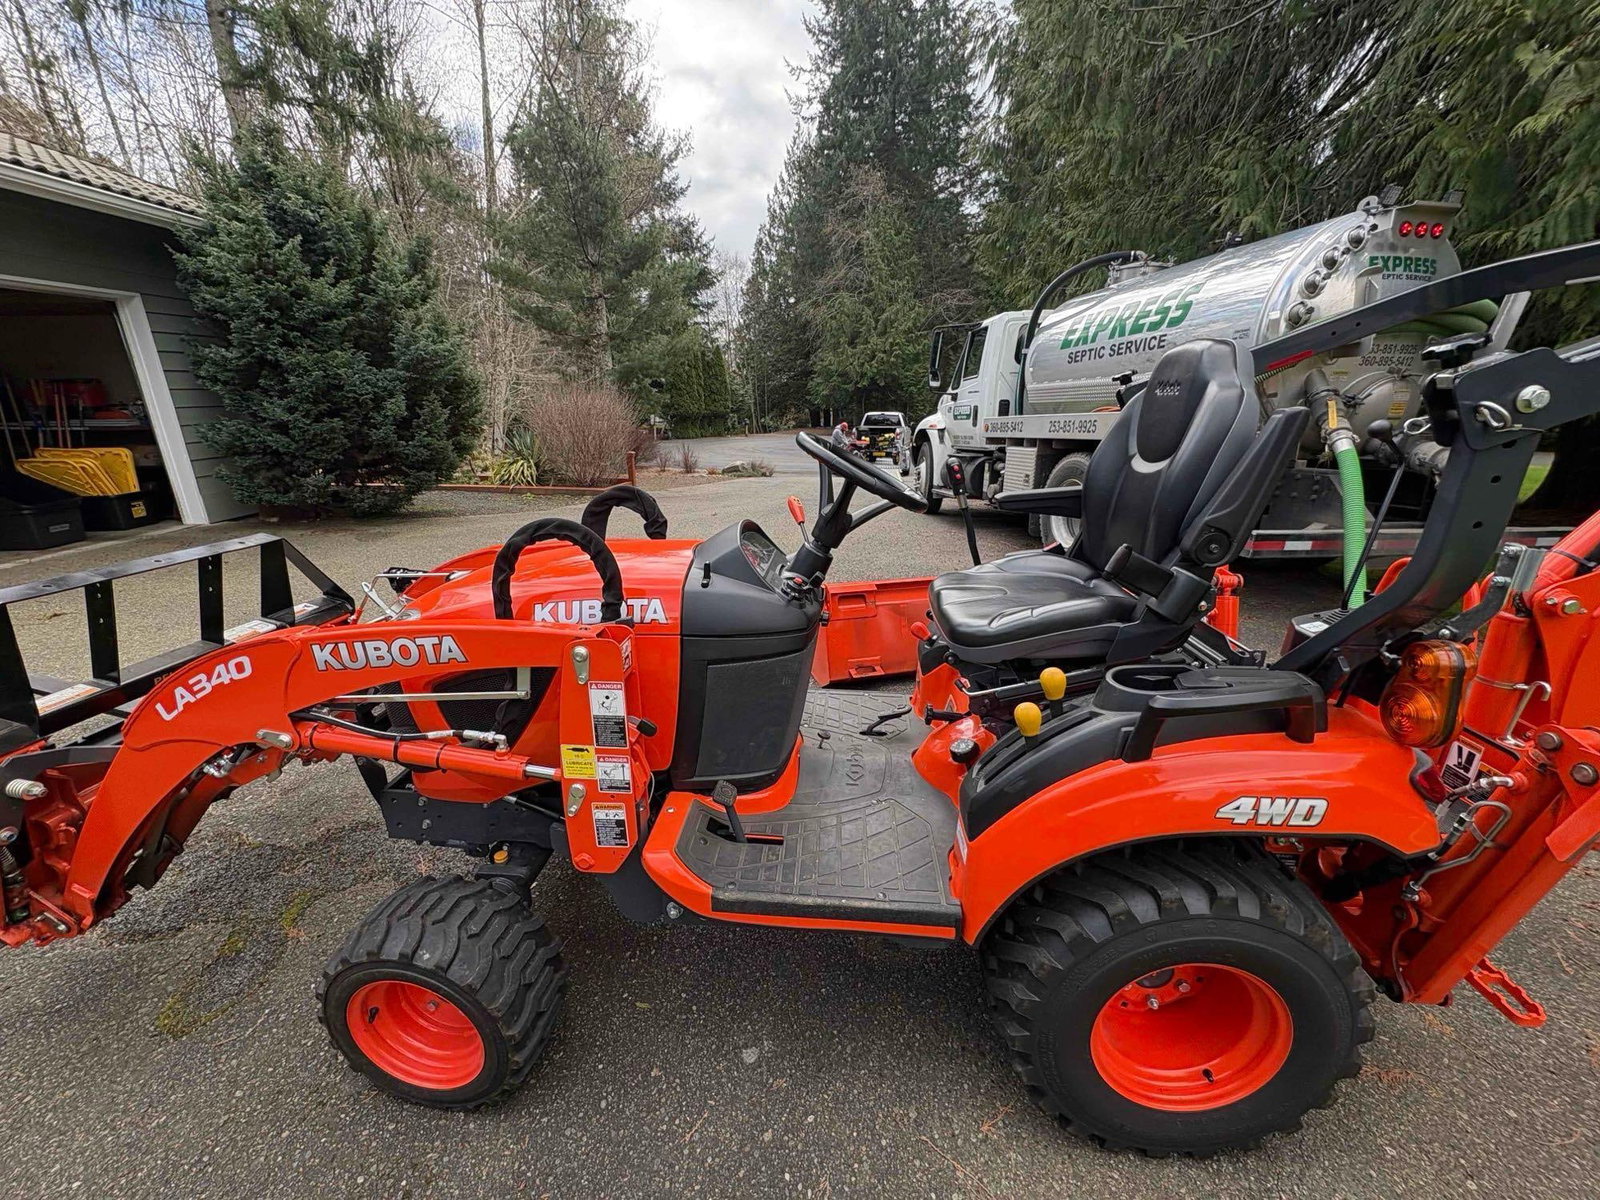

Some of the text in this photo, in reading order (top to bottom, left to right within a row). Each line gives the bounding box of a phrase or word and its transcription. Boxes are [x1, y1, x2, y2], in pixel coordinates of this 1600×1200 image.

[1368, 255, 1437, 276] EXPRESS
[1060, 282, 1206, 350] EXPRESS
[1067, 333, 1168, 365] SEPTIC SERVICE
[1358, 356, 1414, 367] 360-895-5412
[1369, 343, 1418, 355] 53-851-9925
[989, 420, 1098, 434] 360-895-5412 253-851-9925
[533, 597, 669, 625] KUBTA
[310, 634, 470, 672] KUBOTA
[155, 655, 253, 721] LA340
[1214, 795, 1330, 827] 4WD
